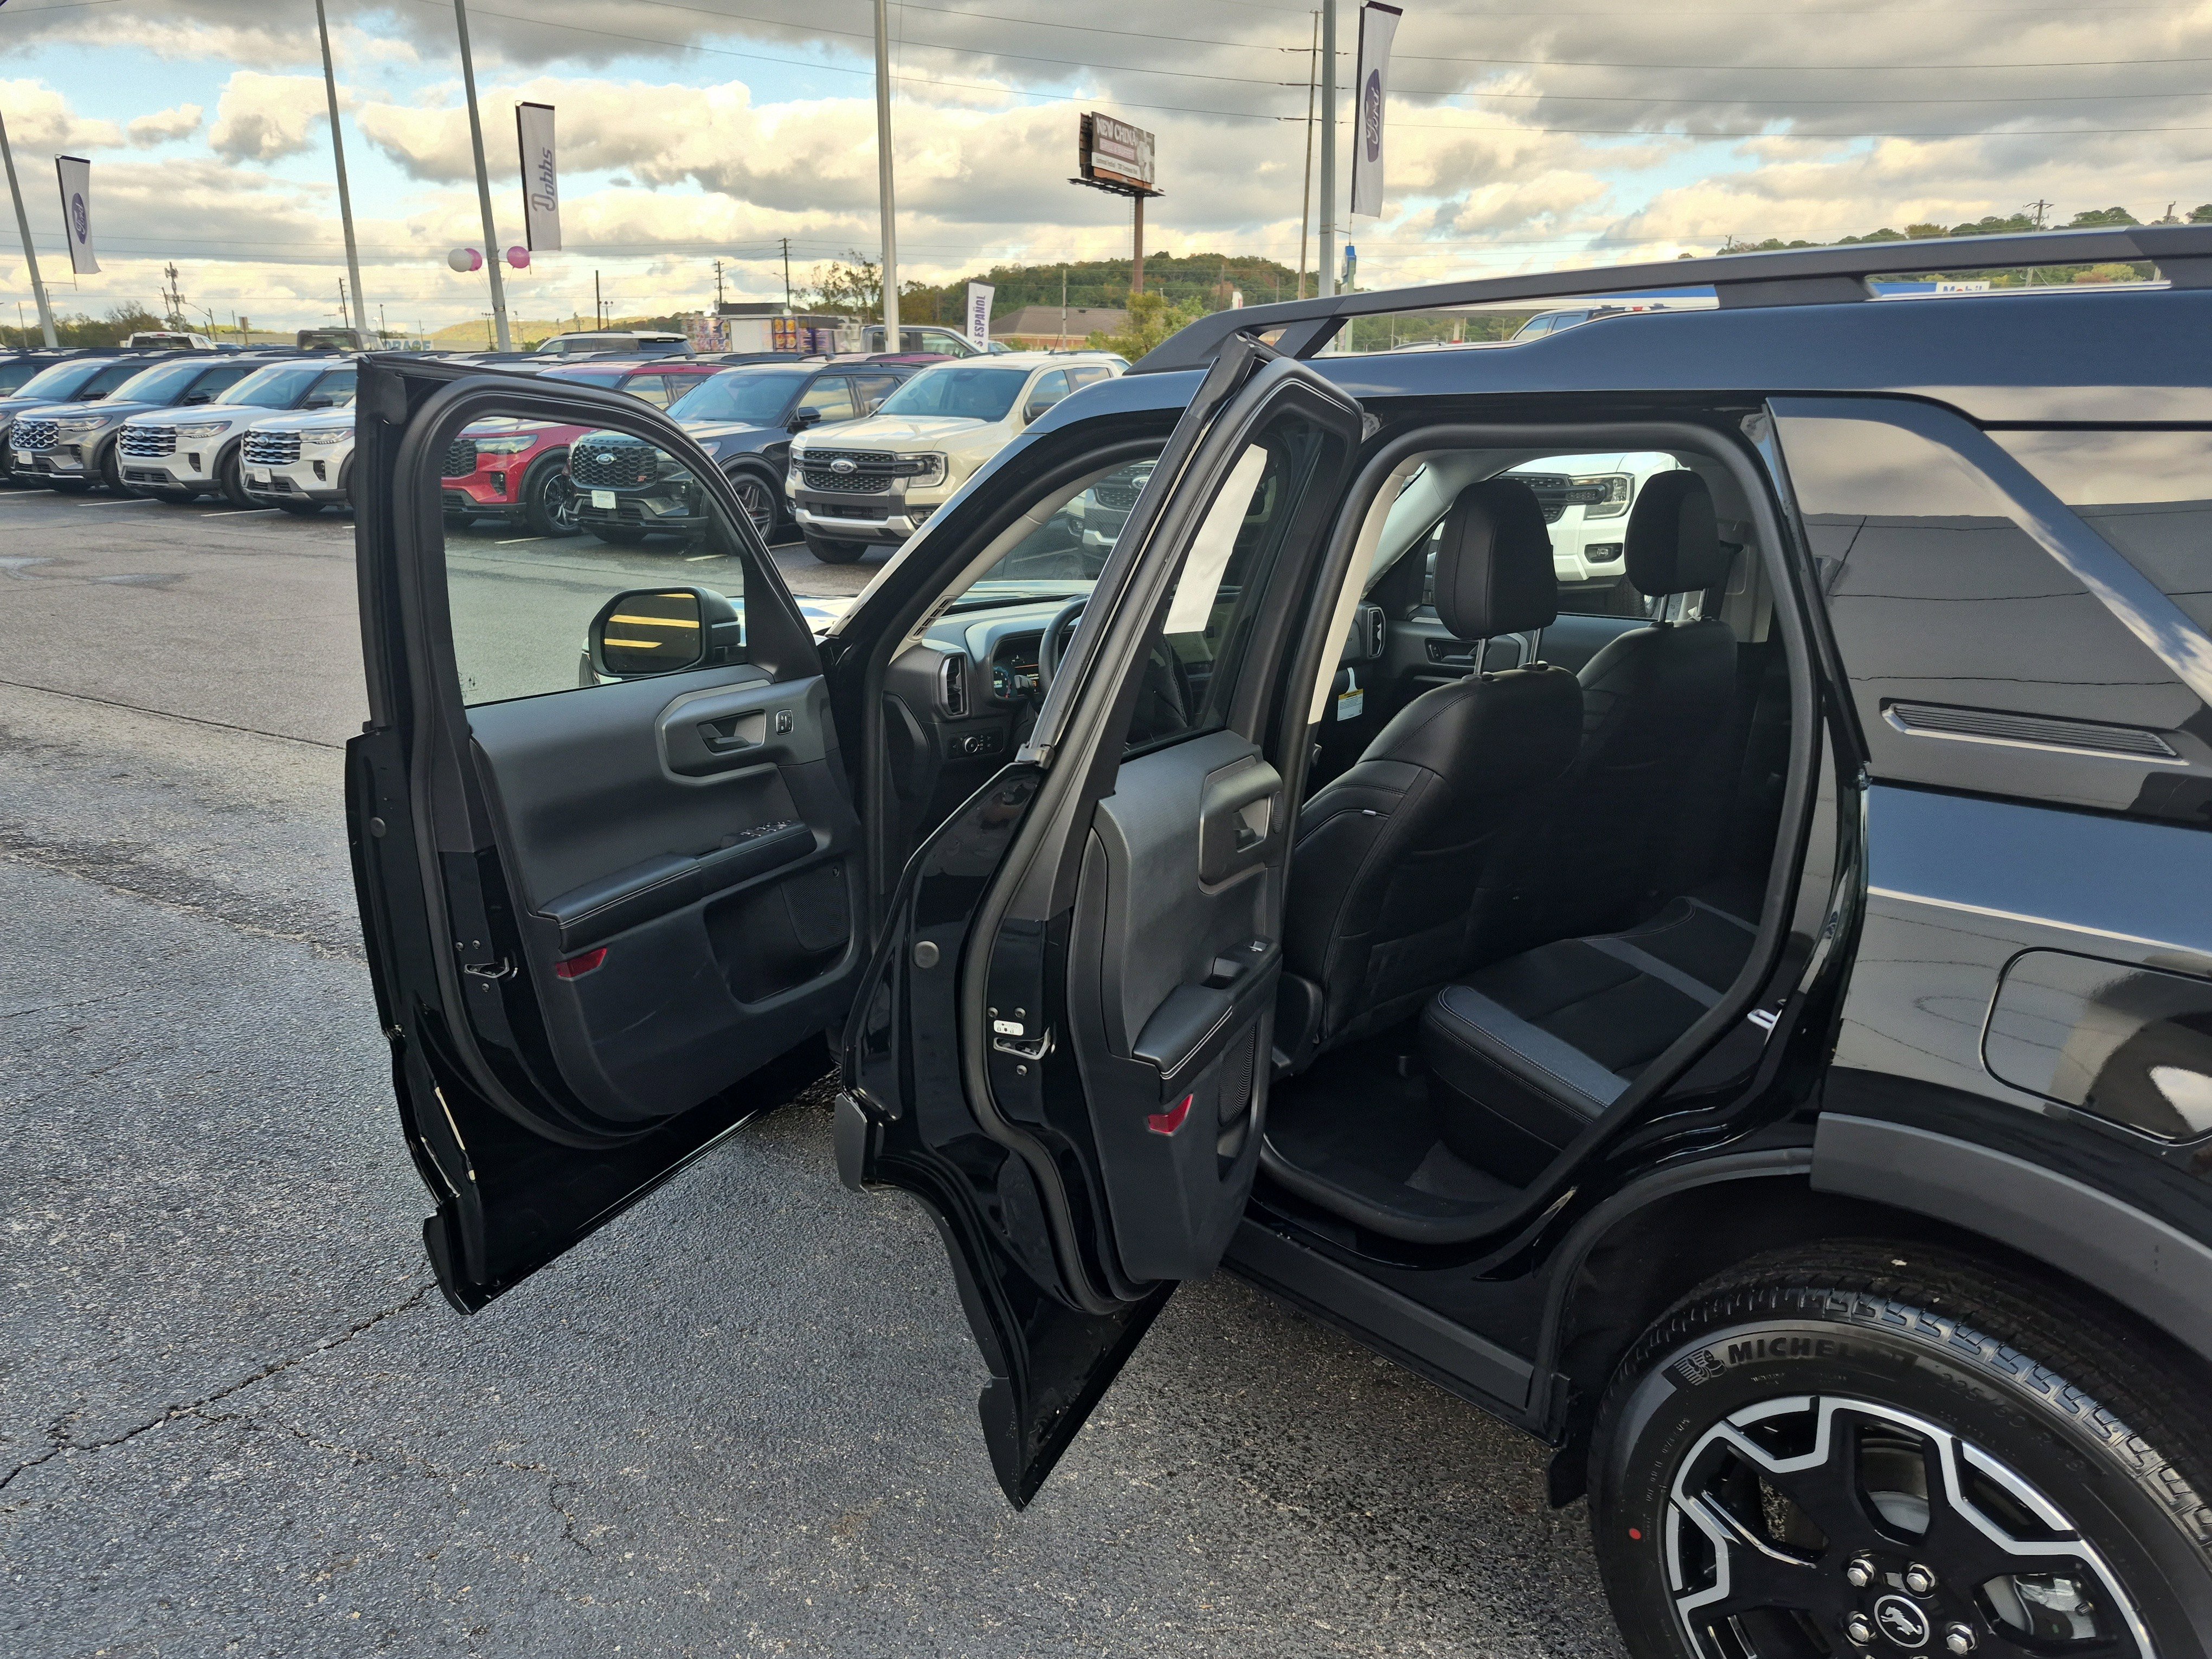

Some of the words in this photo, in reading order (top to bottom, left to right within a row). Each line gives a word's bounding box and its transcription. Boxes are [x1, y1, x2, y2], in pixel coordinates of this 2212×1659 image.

[531, 147, 556, 211] Dobbs
[74, 203, 86, 235] Ford
[973, 295, 986, 337] ESPAÑOL
